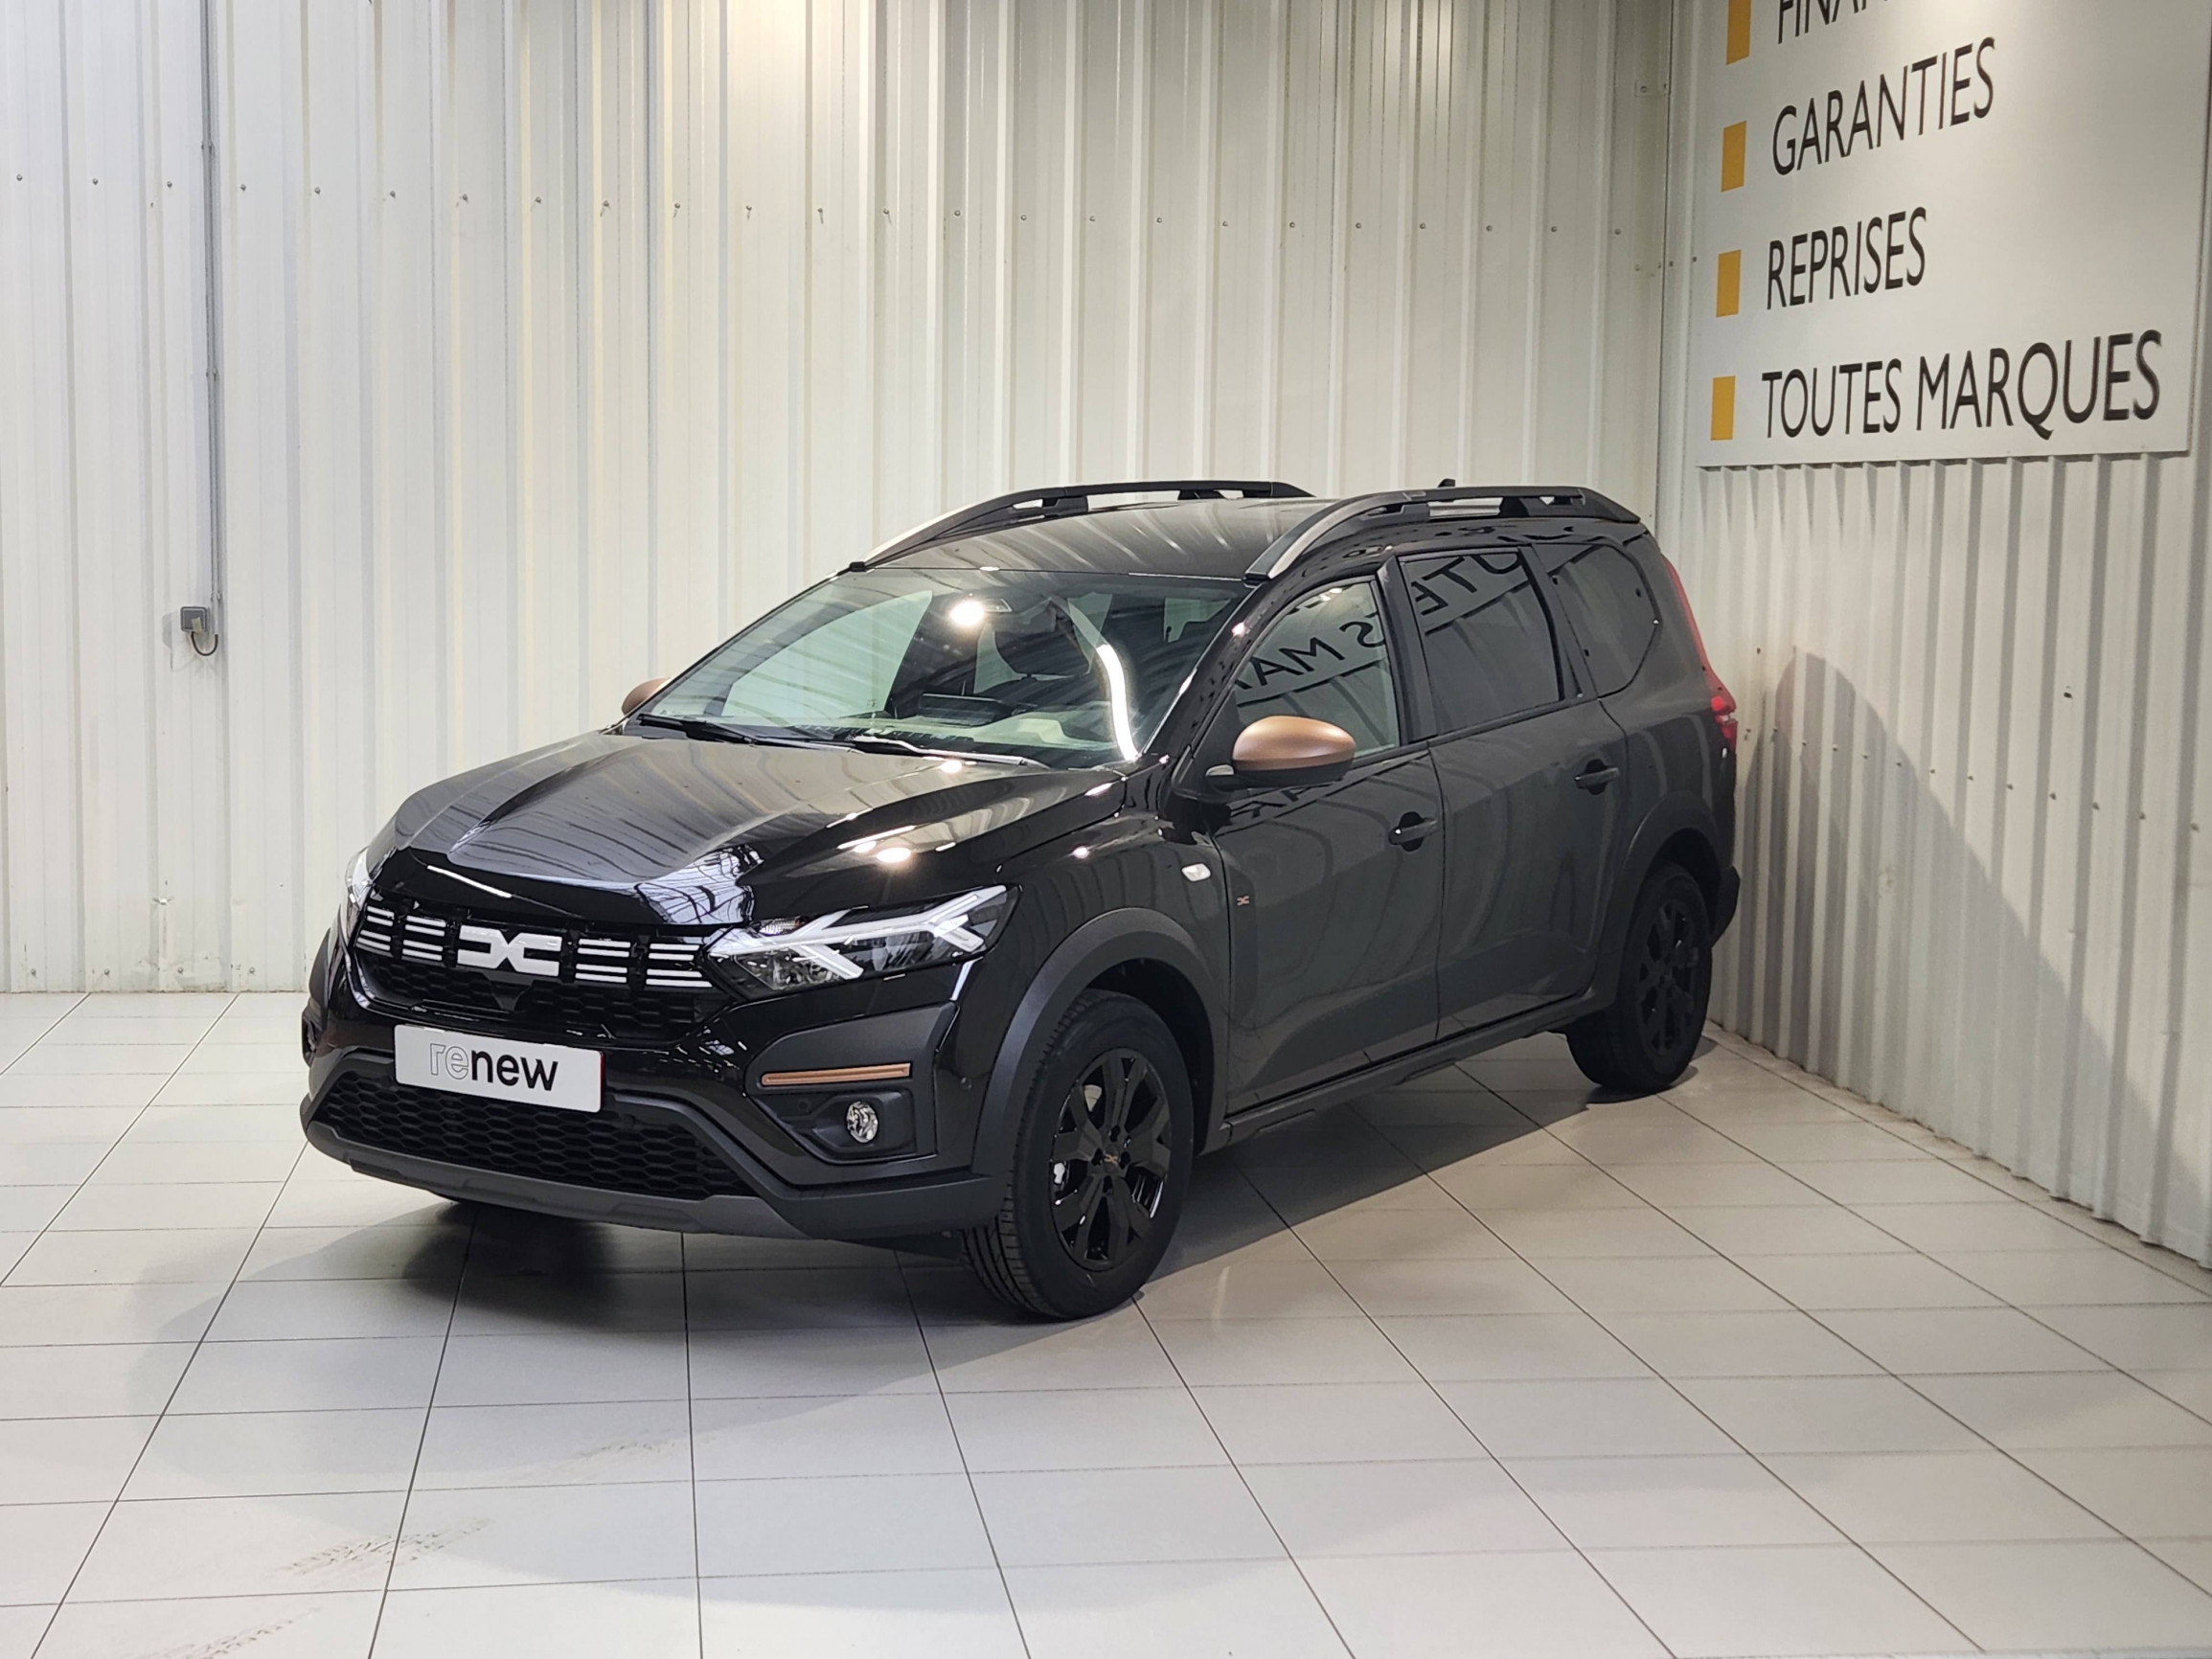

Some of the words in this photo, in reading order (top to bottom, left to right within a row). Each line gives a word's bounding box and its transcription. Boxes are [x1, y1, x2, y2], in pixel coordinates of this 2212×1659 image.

[1772, 36, 1995, 175] GARANTIES
[1767, 207, 1927, 309] REPRISES
[1762, 358, 1902, 438] TOUTES
[1916, 330, 2162, 441] MARQUES
[429, 1042, 559, 1091] renew
